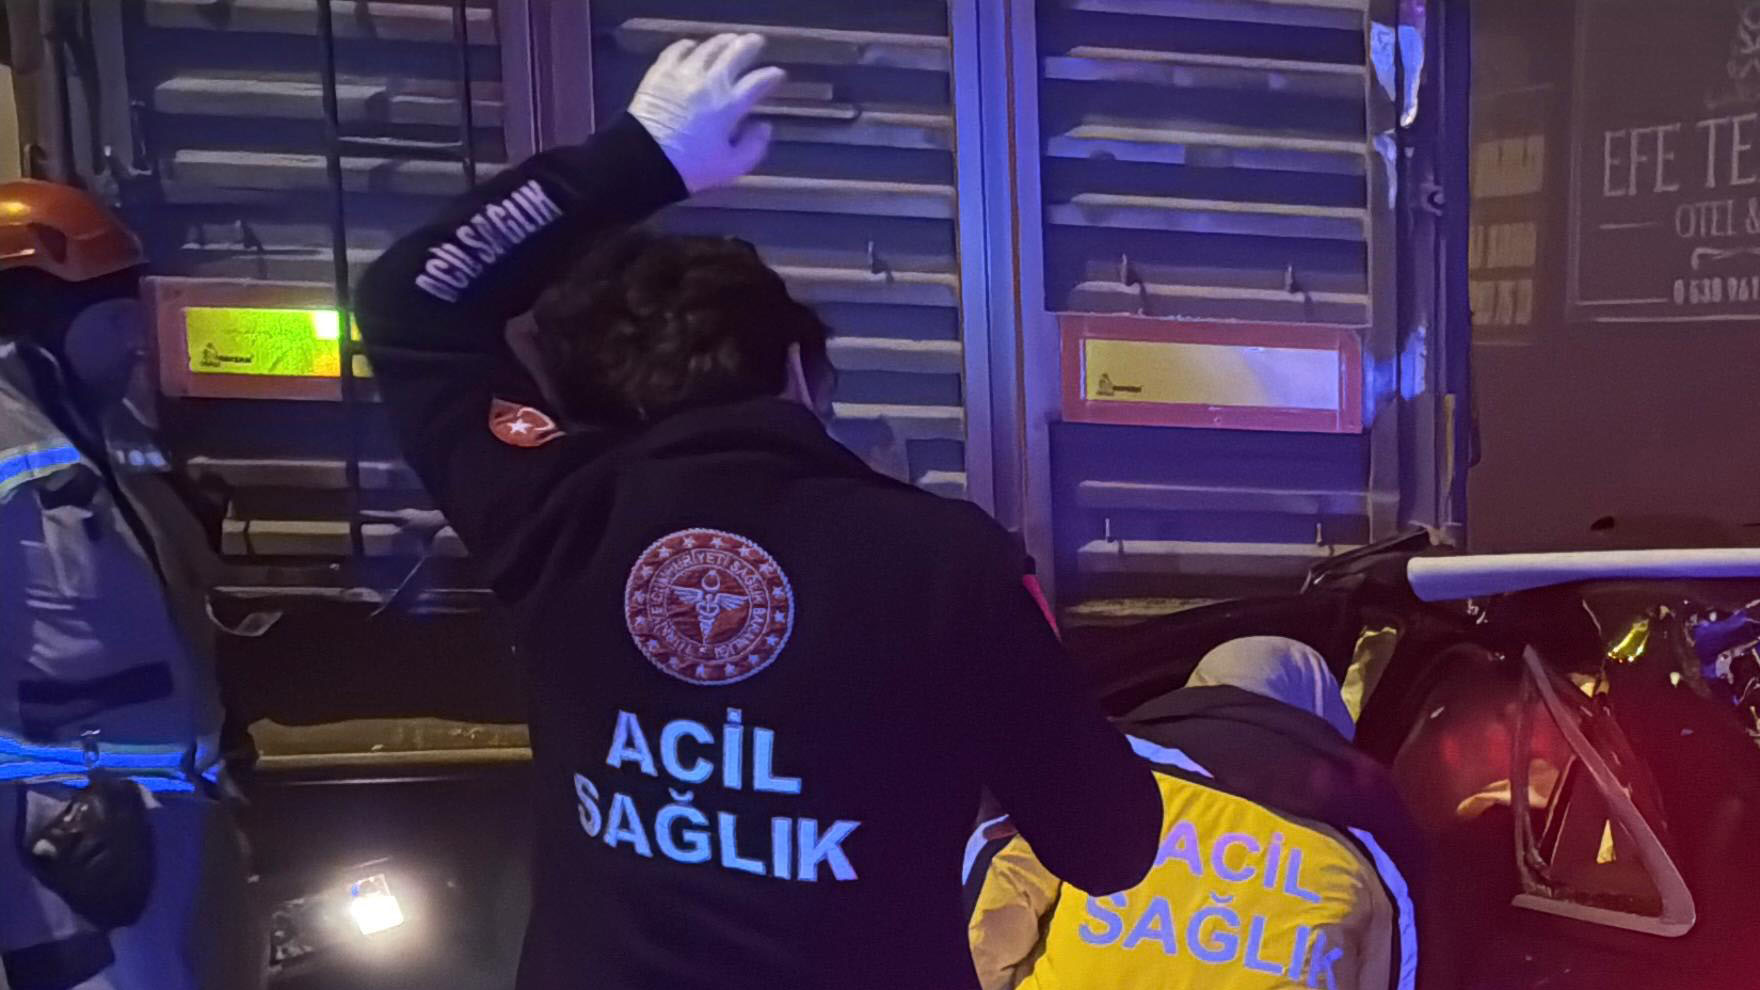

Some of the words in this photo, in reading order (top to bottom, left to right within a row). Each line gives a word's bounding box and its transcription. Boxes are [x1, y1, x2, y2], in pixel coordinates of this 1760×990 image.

[1602, 122, 1682, 197] EFE
[1674, 199, 1737, 239] OTEL
[606, 707, 803, 795] ACİL
[574, 773, 862, 882] SAĞLIK
[1152, 819, 1323, 904] ACİL
